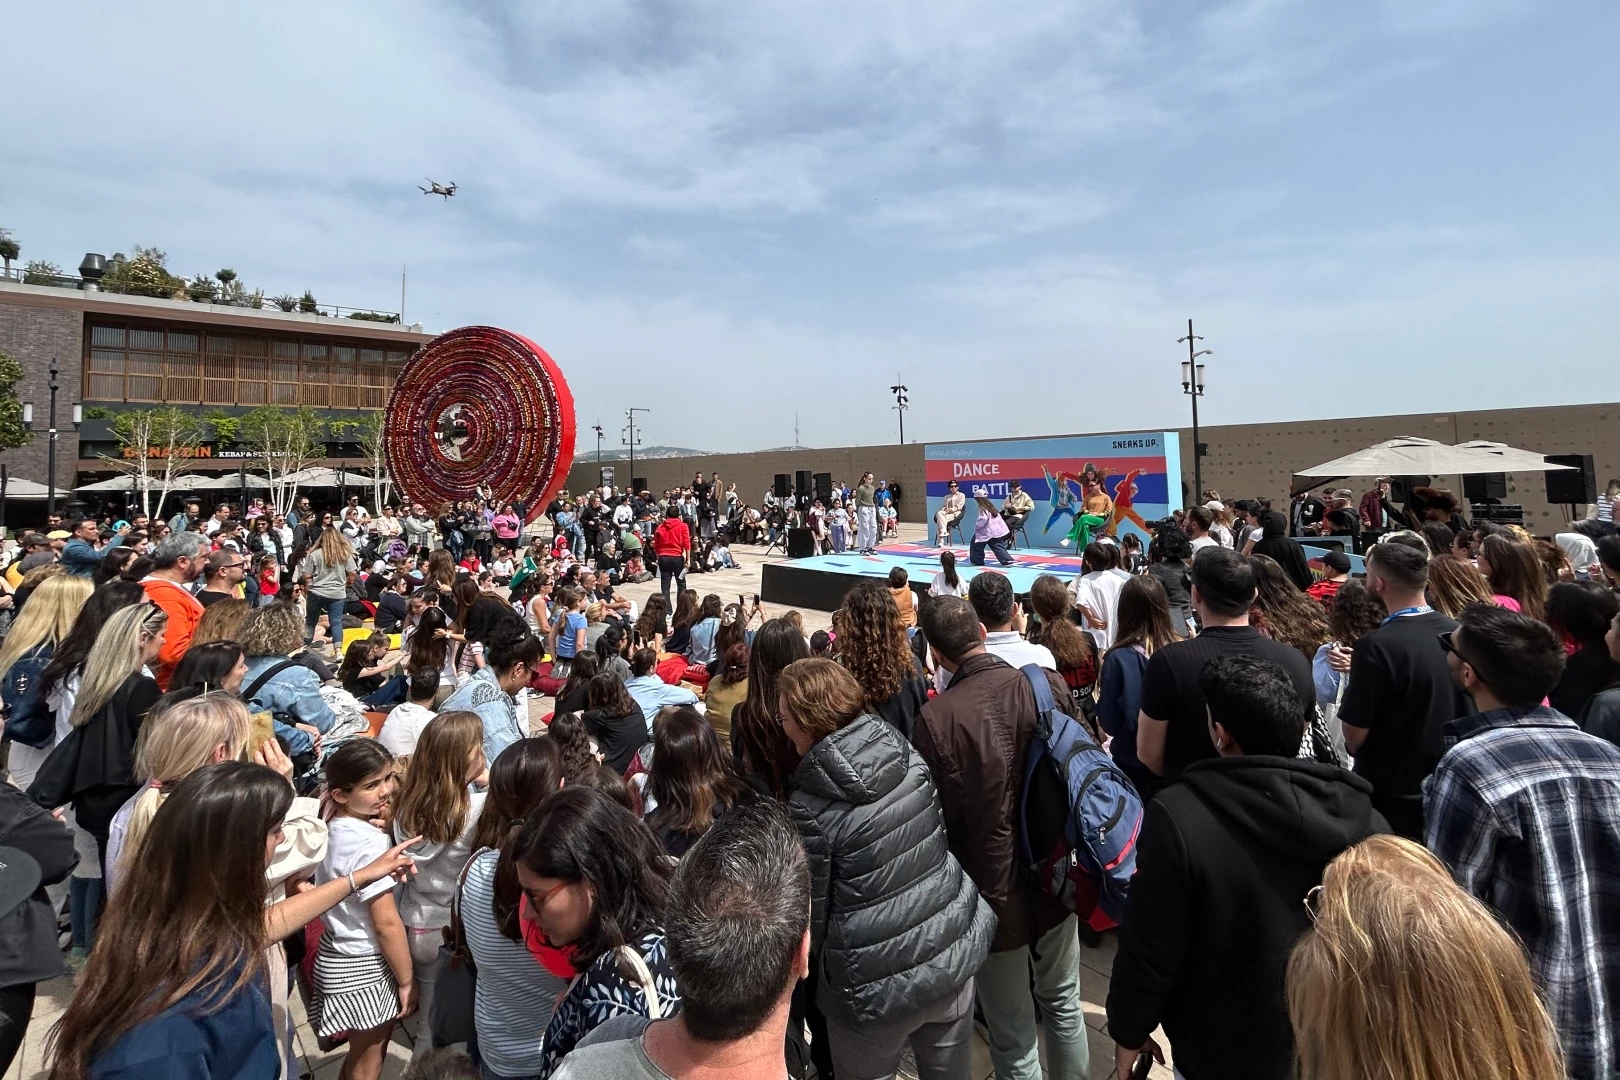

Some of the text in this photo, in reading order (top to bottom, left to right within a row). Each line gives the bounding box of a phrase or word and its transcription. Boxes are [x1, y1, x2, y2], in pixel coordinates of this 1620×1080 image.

[1112, 440, 1144, 449] SNEAKS
[953, 462, 1000, 478] DANCE
[972, 482, 1012, 496] BATTL
